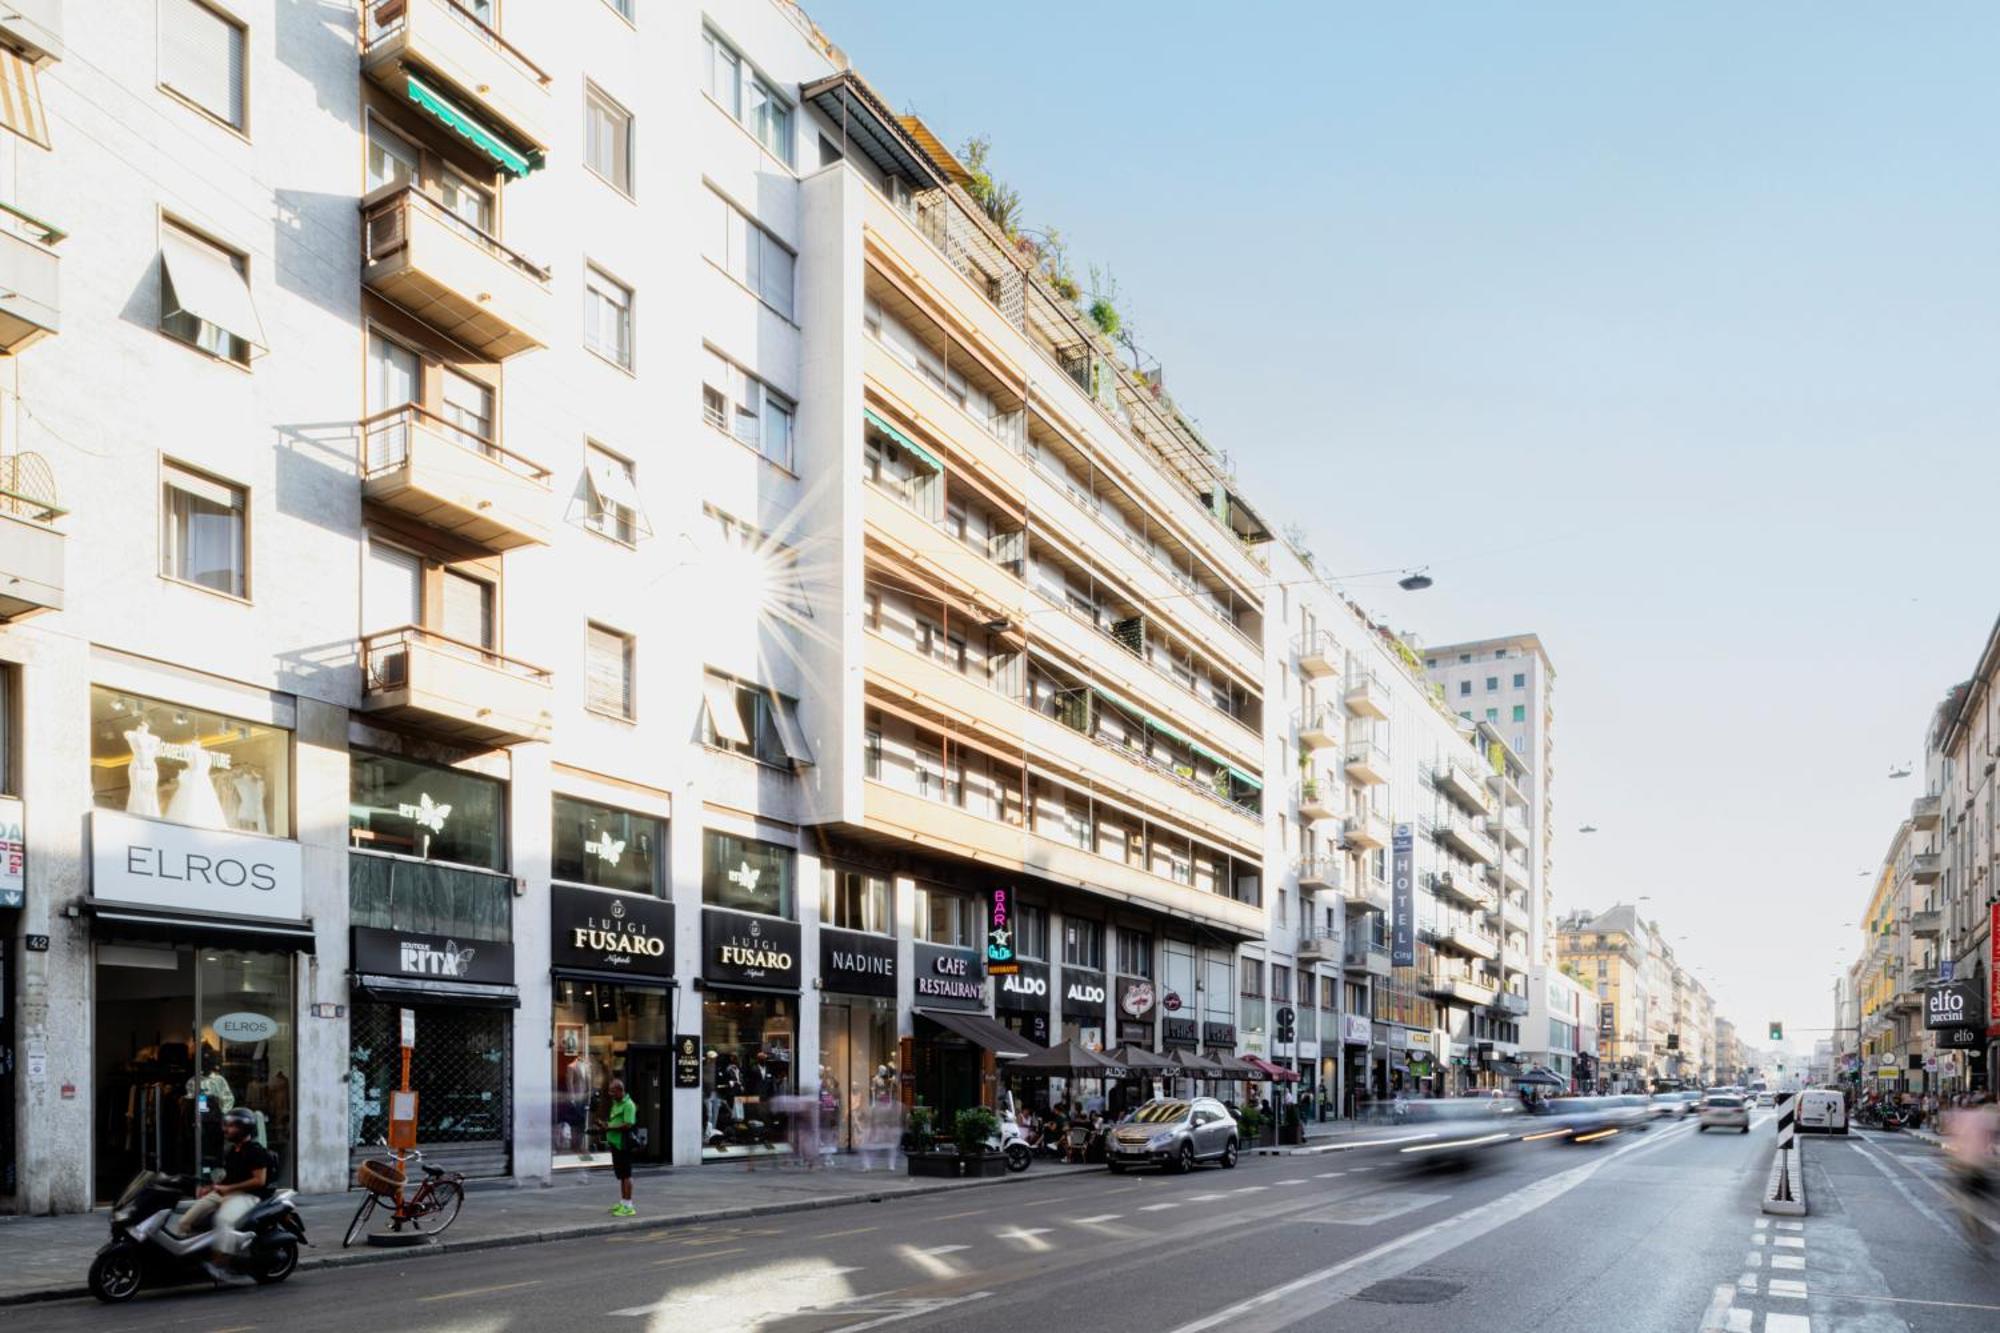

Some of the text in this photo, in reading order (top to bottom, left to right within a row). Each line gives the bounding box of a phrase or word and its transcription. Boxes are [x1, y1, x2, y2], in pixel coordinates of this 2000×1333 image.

[127, 845, 276, 891] ELROS
[994, 890, 1006, 925] BAR
[1396, 859, 1409, 944] HOTEL
[588, 917, 647, 935] LUIGI
[30, 936, 48, 949] 42
[574, 928, 665, 956] FUSARO
[732, 935, 777, 951] LUIGI
[401, 948, 458, 976] RITA
[721, 945, 792, 970] FUSARO
[832, 951, 893, 976] NADINE
[1393, 951, 1412, 961] City
[918, 977, 982, 999] RESTAURANT
[1003, 975, 1046, 996] ALDO
[1068, 984, 1105, 1003] ALDO
[1930, 990, 1963, 1012] elfo
[224, 1021, 268, 1032] ELROS
[1930, 1010, 1963, 1024] puccini
[1953, 1028, 1974, 1042] elfo
[1105, 1067, 1127, 1077] ALDO
[1161, 1068, 1180, 1077] ALDO
